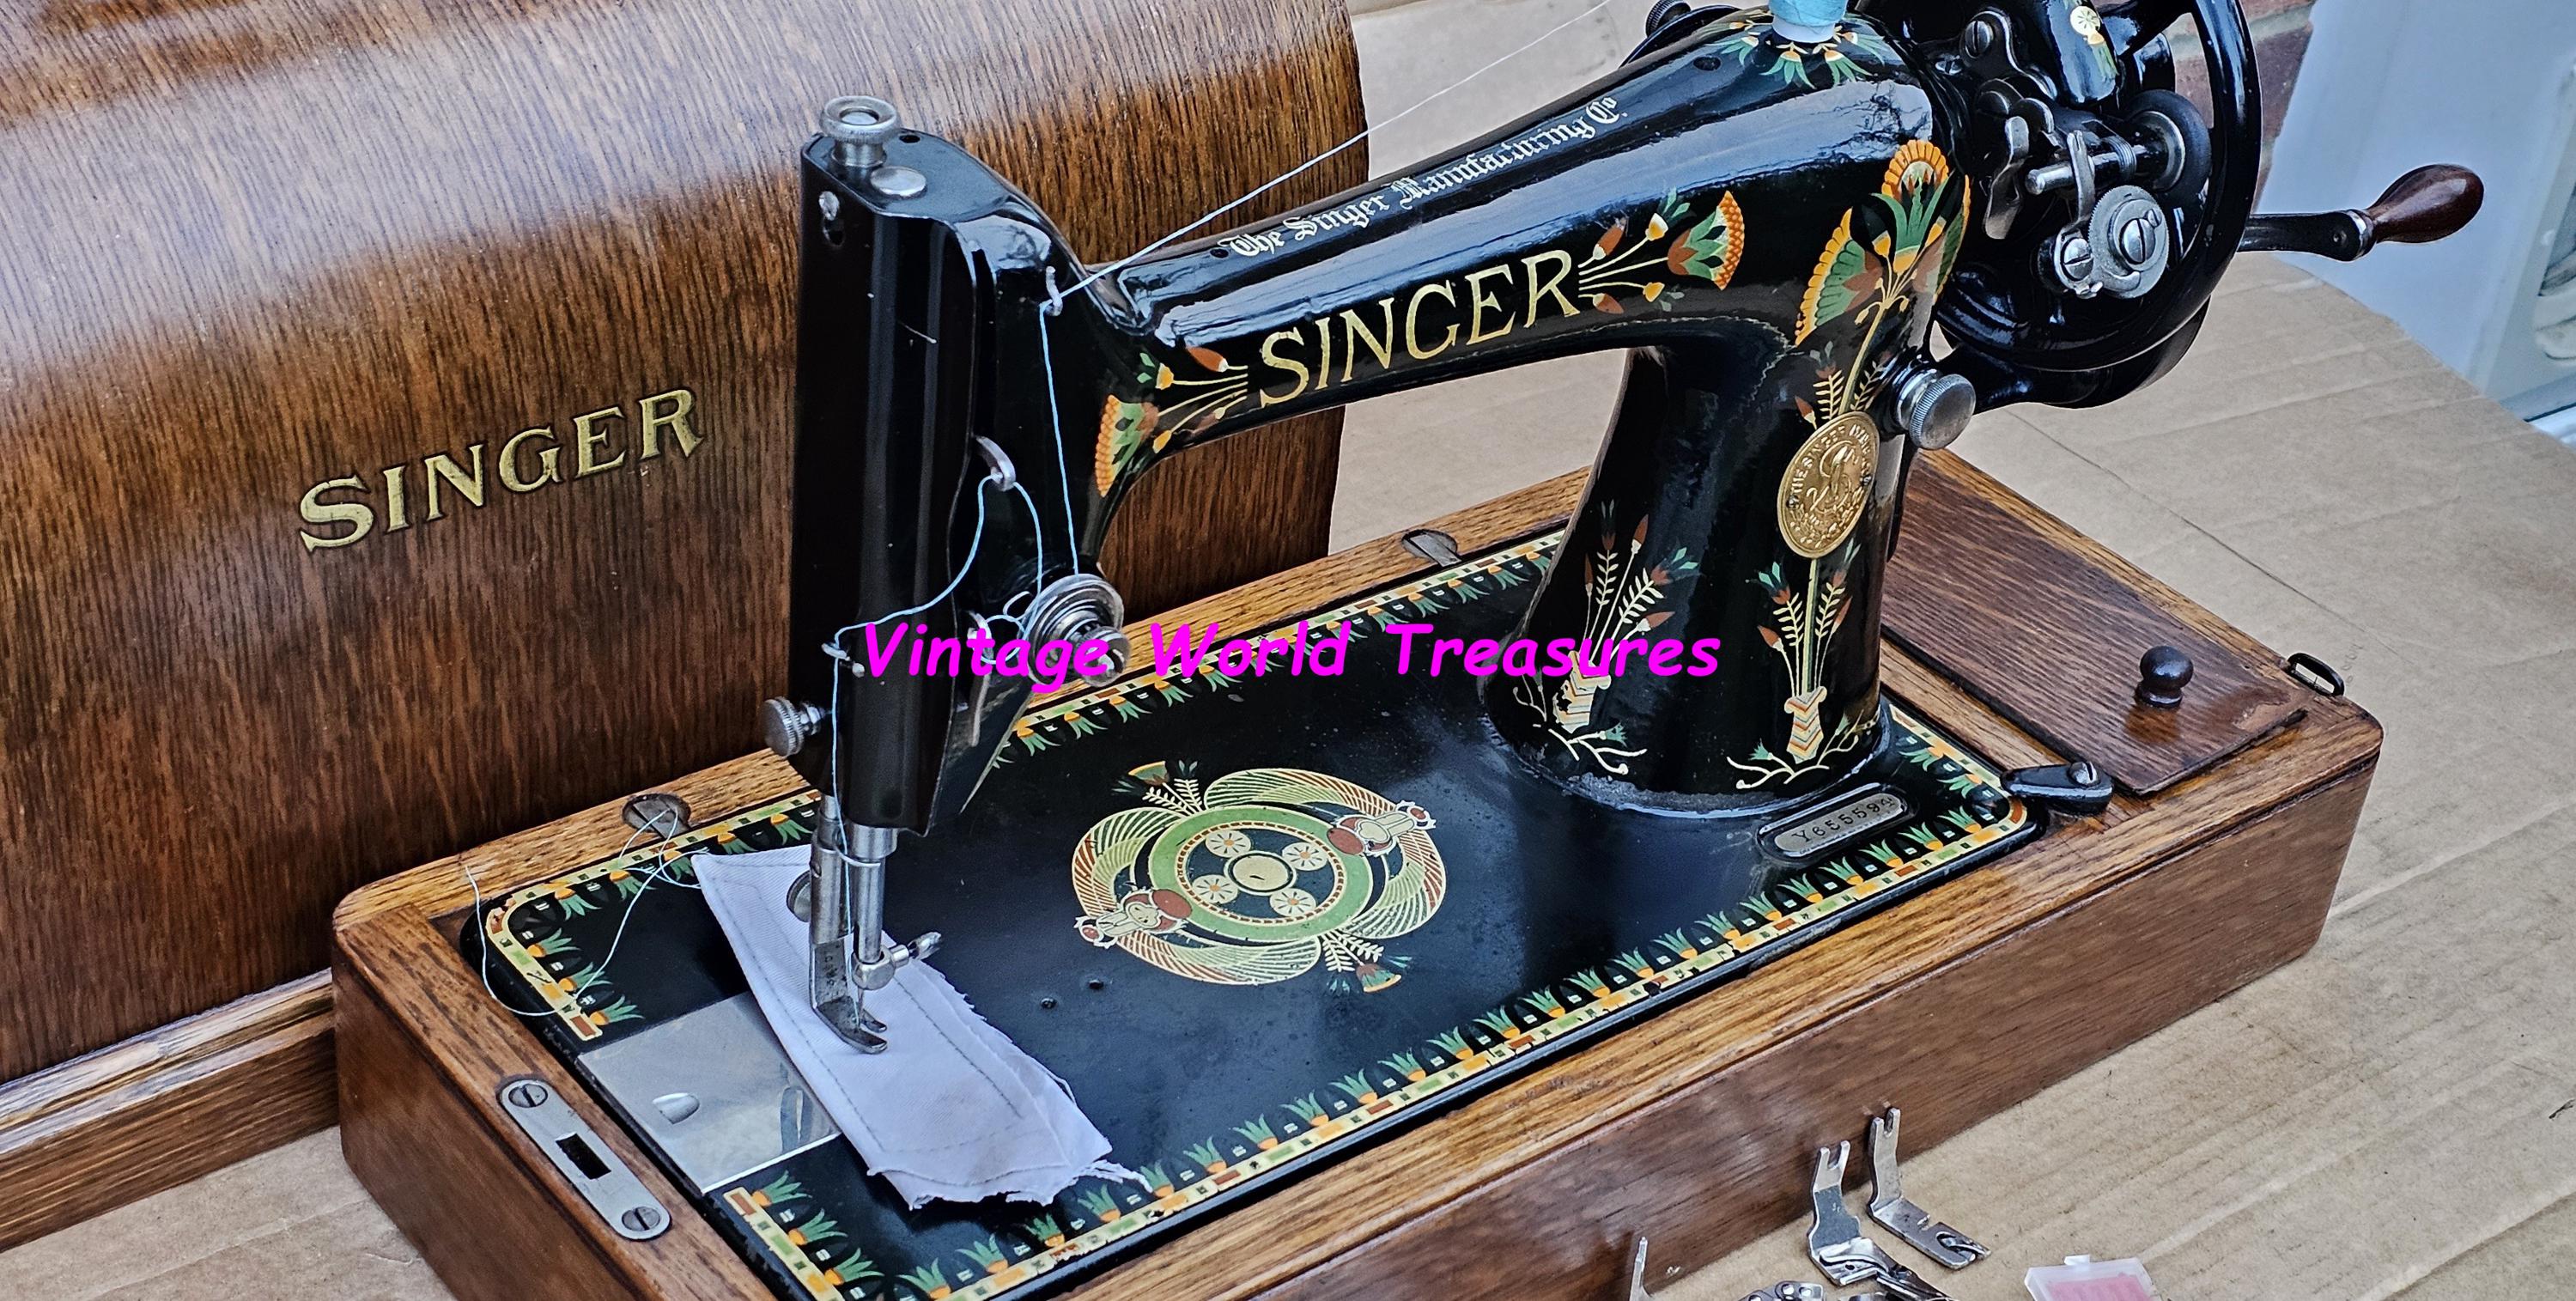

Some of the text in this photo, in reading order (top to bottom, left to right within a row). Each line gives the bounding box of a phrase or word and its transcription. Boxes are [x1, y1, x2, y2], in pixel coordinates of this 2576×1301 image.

[1217, 233, 1285, 257] The
[1283, 194, 1390, 241] Singer
[1388, 116, 1596, 210] Manufacturing
[1260, 249, 1581, 410] SINGER
[298, 388, 705, 553] SINGER
